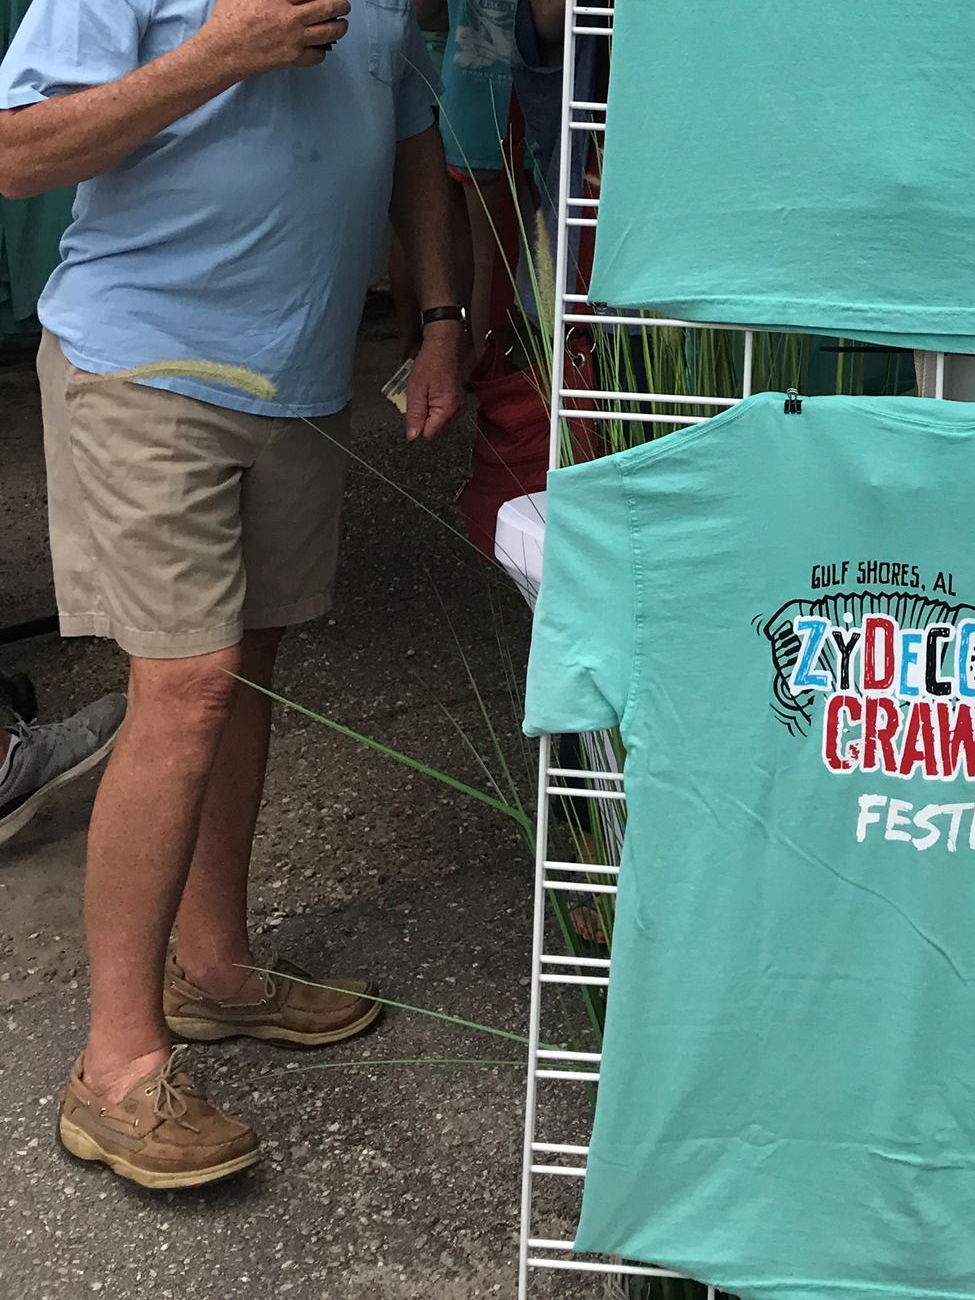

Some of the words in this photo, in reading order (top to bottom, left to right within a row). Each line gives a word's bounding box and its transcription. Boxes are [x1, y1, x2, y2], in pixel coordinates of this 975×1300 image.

[811, 560, 850, 589] GULF
[856, 559, 926, 592] SHORES,
[933, 571, 957, 596] AL
